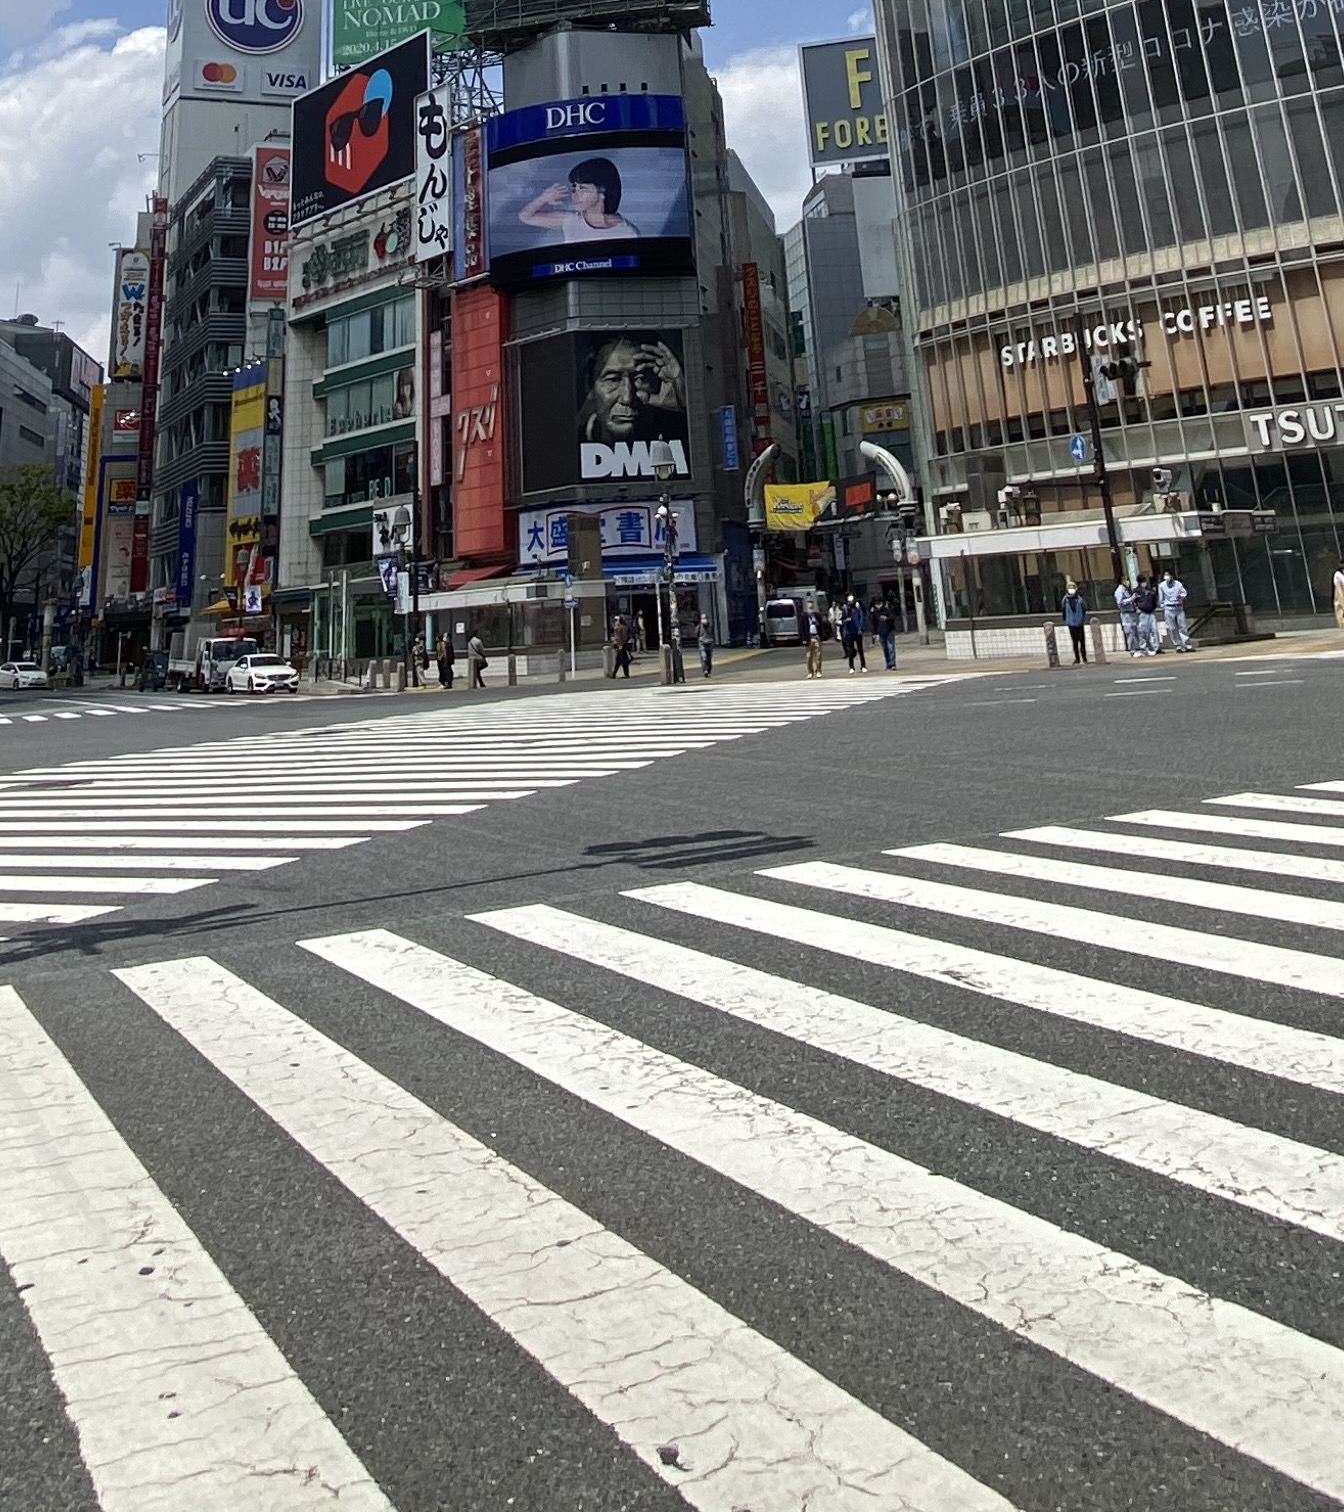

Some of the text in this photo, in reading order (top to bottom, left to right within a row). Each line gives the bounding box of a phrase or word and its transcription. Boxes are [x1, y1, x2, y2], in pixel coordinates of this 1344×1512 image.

[344, 1, 440, 30] NOMAD
[267, 73, 306, 88] VISA
[845, 49, 872, 109] F
[545, 102, 606, 129] DHC
[418, 93, 449, 250] もんじゃ
[554, 258, 612, 274] DHC Channel
[1001, 296, 1272, 369] STARBUCKS COFFEE
[580, 439, 688, 479] DMM
[527, 510, 668, 552] 大盛書
